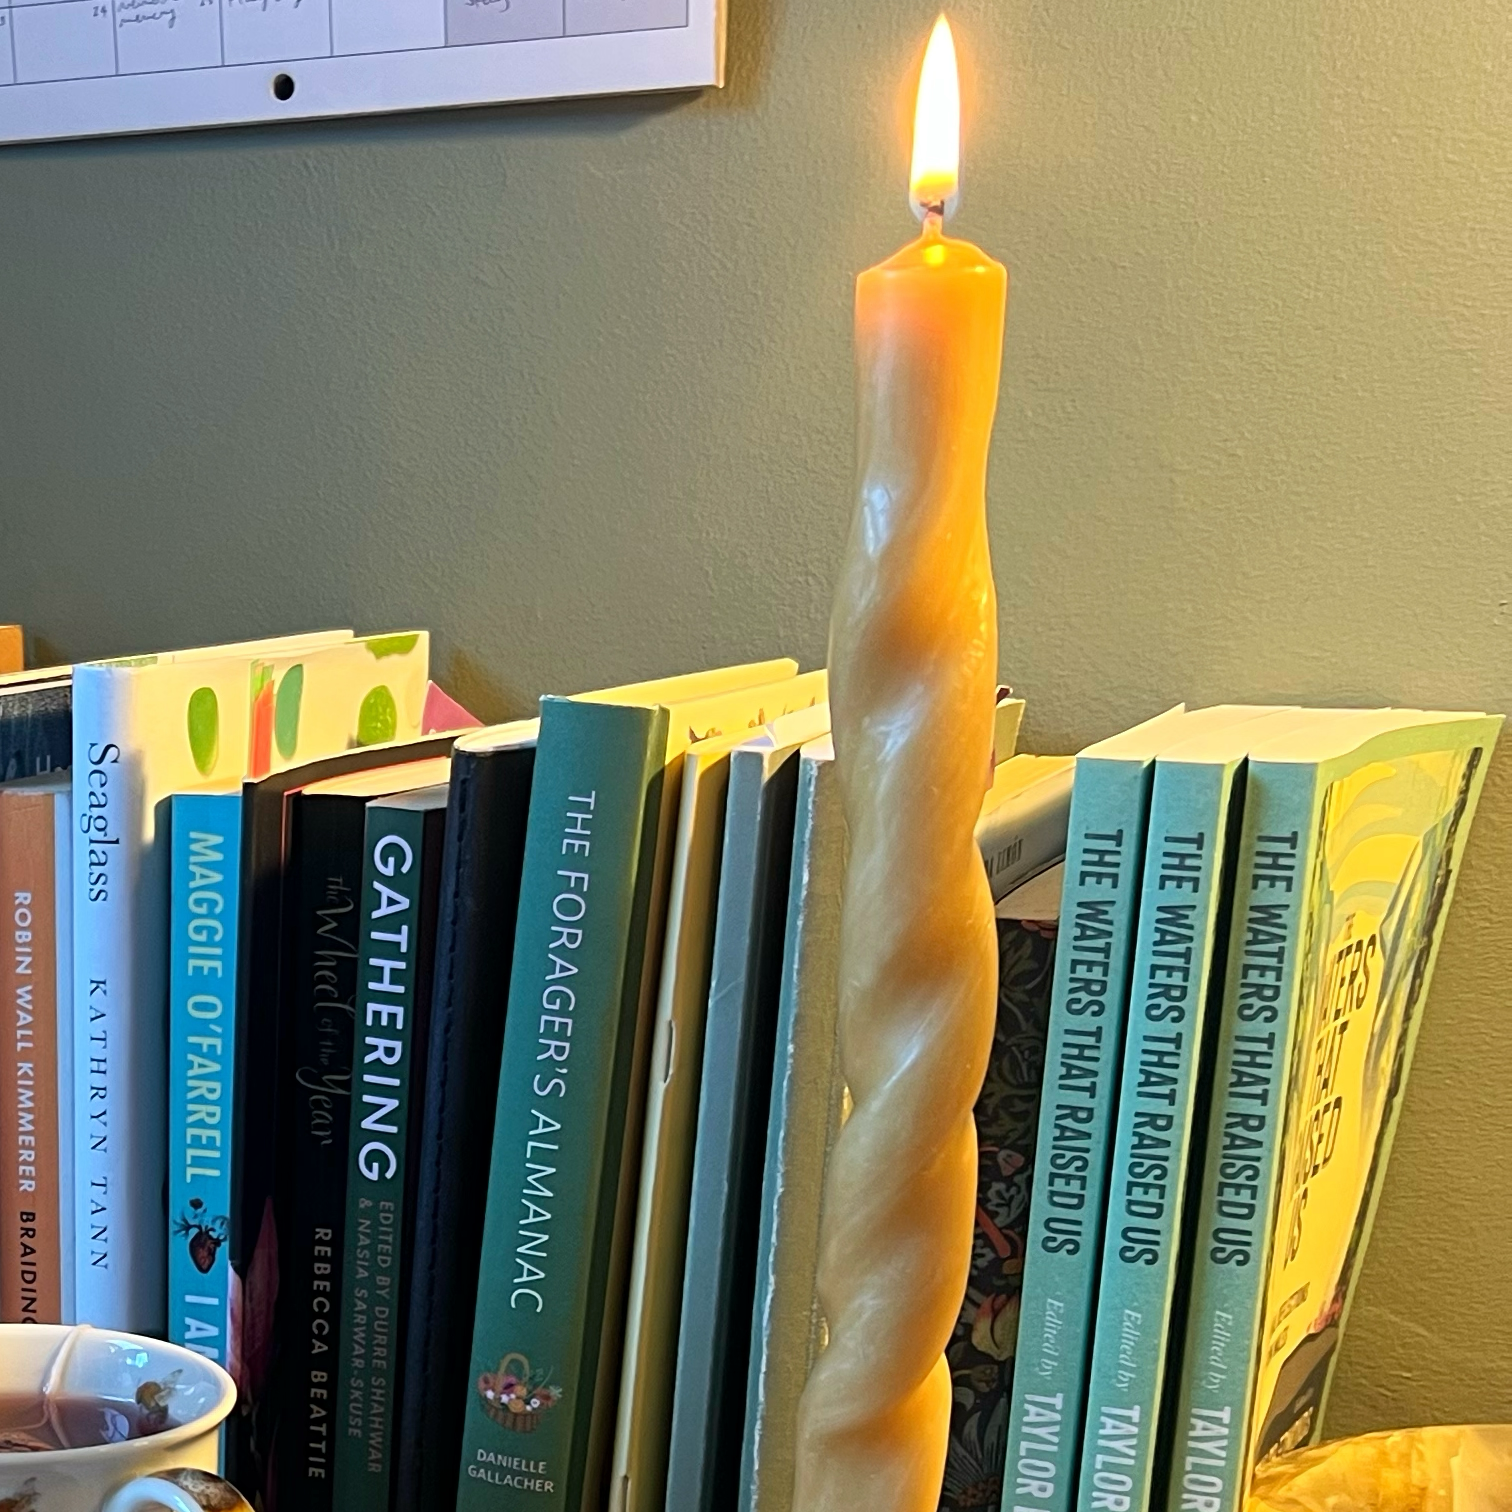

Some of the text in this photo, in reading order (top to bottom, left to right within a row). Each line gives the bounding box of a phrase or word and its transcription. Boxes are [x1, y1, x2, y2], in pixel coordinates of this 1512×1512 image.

[79, 743, 120, 1269] Seaglass KATHRYN TANN
[185, 831, 224, 1184] MAGGIE O'FARRELL
[314, 898, 359, 1020] Wheel
[358, 834, 413, 1181] GATHERING
[14, 891, 36, 1192] ROBIN WALL KIMMERER
[319, 1038, 337, 1066] the
[320, 1017, 339, 1037] of
[510, 790, 596, 1312] THE FORAGER'S ALMANAC
[1040, 829, 1123, 1257] THE WATERS THAT RAISED US
[1119, 832, 1205, 1266] THE WATERS THAT RAISED US
[1210, 831, 1299, 1267] THE WATERS THAT RAISED US
[295, 1065, 353, 1147] Year
[184, 1294, 219, 1306] I
[355, 1218, 371, 1279] NASIA
[308, 1227, 332, 1479] REBECCA BEATTIE
[348, 1289, 368, 1438] SARWAR-SKUSE
[367, 1201, 395, 1473] EDITED BY DURRE SHAHWAR
[1037, 1359, 1057, 1381] by
[1041, 1297, 1065, 1358] Edited
[1114, 1370, 1134, 1392] by
[1117, 1308, 1142, 1369] Edited
[1209, 1309, 1234, 1370] Edited
[1203, 1370, 1227, 1393] by
[467, 1464, 555, 1494] GALLACHER
[476, 1449, 548, 1475] DANIELLE
[1015, 1392, 1063, 1499] TAYLOR
[1091, 1404, 1141, 1512] TAYLOR
[1182, 1405, 1231, 1512] TAYLOR
